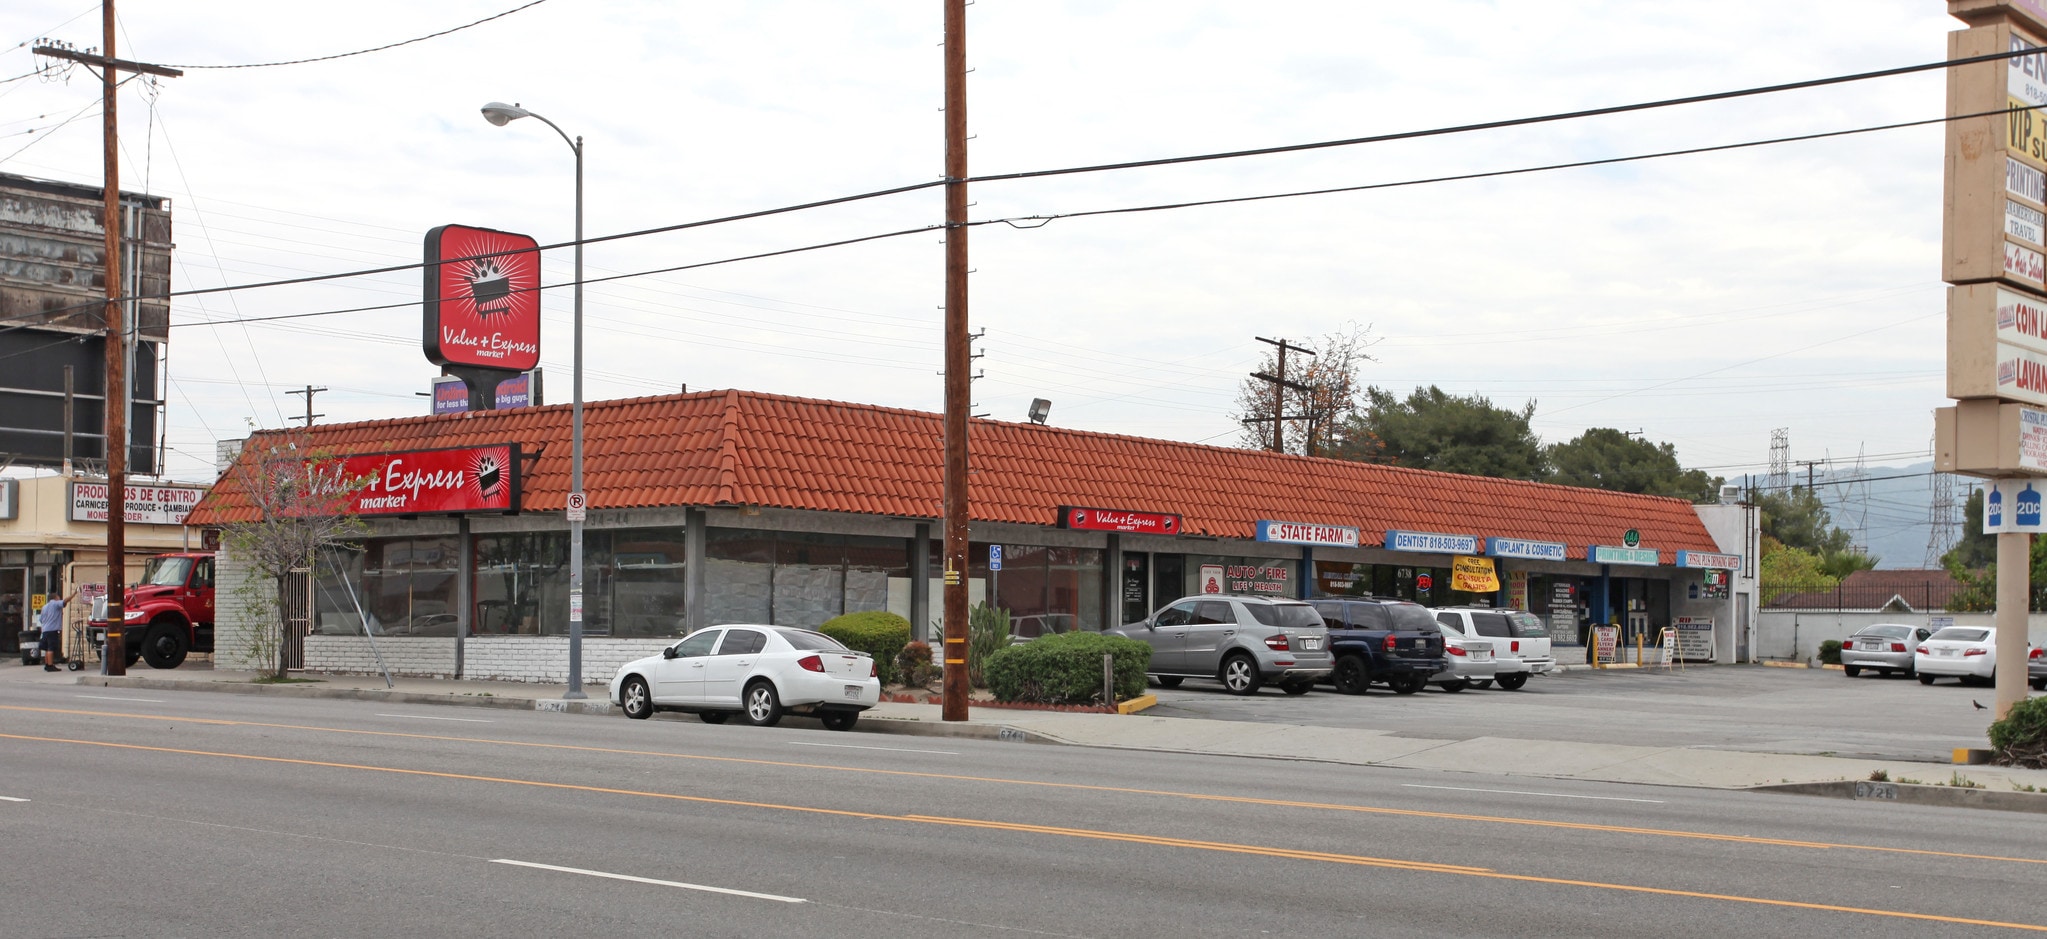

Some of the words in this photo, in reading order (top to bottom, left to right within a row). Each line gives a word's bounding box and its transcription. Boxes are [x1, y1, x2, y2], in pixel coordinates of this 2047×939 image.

[2006, 159, 2046, 203] PRINTING
[2010, 220, 2036, 242] TRAVEL
[2016, 303, 2038, 338] COIN
[443, 326, 478, 345] Value
[492, 332, 537, 356] Express
[476, 349, 504, 358] market
[446, 400, 459, 408] less
[501, 395, 511, 404] big
[385, 458, 465, 501] Express
[76, 485, 137, 501] PRODUOS
[140, 488, 153, 502] DE
[157, 489, 196, 503] CENTRO
[360, 494, 407, 509] market
[86, 511, 109, 519] MONE
[124, 513, 142, 521] RDER
[125, 504, 156, 512] PRODUCE
[1096, 511, 1118, 524] Value
[1126, 513, 1156, 528] Express
[1280, 524, 1312, 541] STATE
[1314, 526, 1344, 543] FARM
[1397, 534, 1428, 548] DENTIST
[1497, 540, 1524, 554] IMPLANT
[1525, 543, 1530, 555] &
[1531, 544, 1563, 557] COSMETIC
[1596, 548, 1629, 561] PRINTING
[1226, 564, 1257, 579] AUTO
[1266, 567, 1287, 580] FIRE
[1457, 573, 1493, 583] CONSULTA
[1232, 580, 1248, 591] LIFE
[1253, 581, 1283, 592] HEALTH
